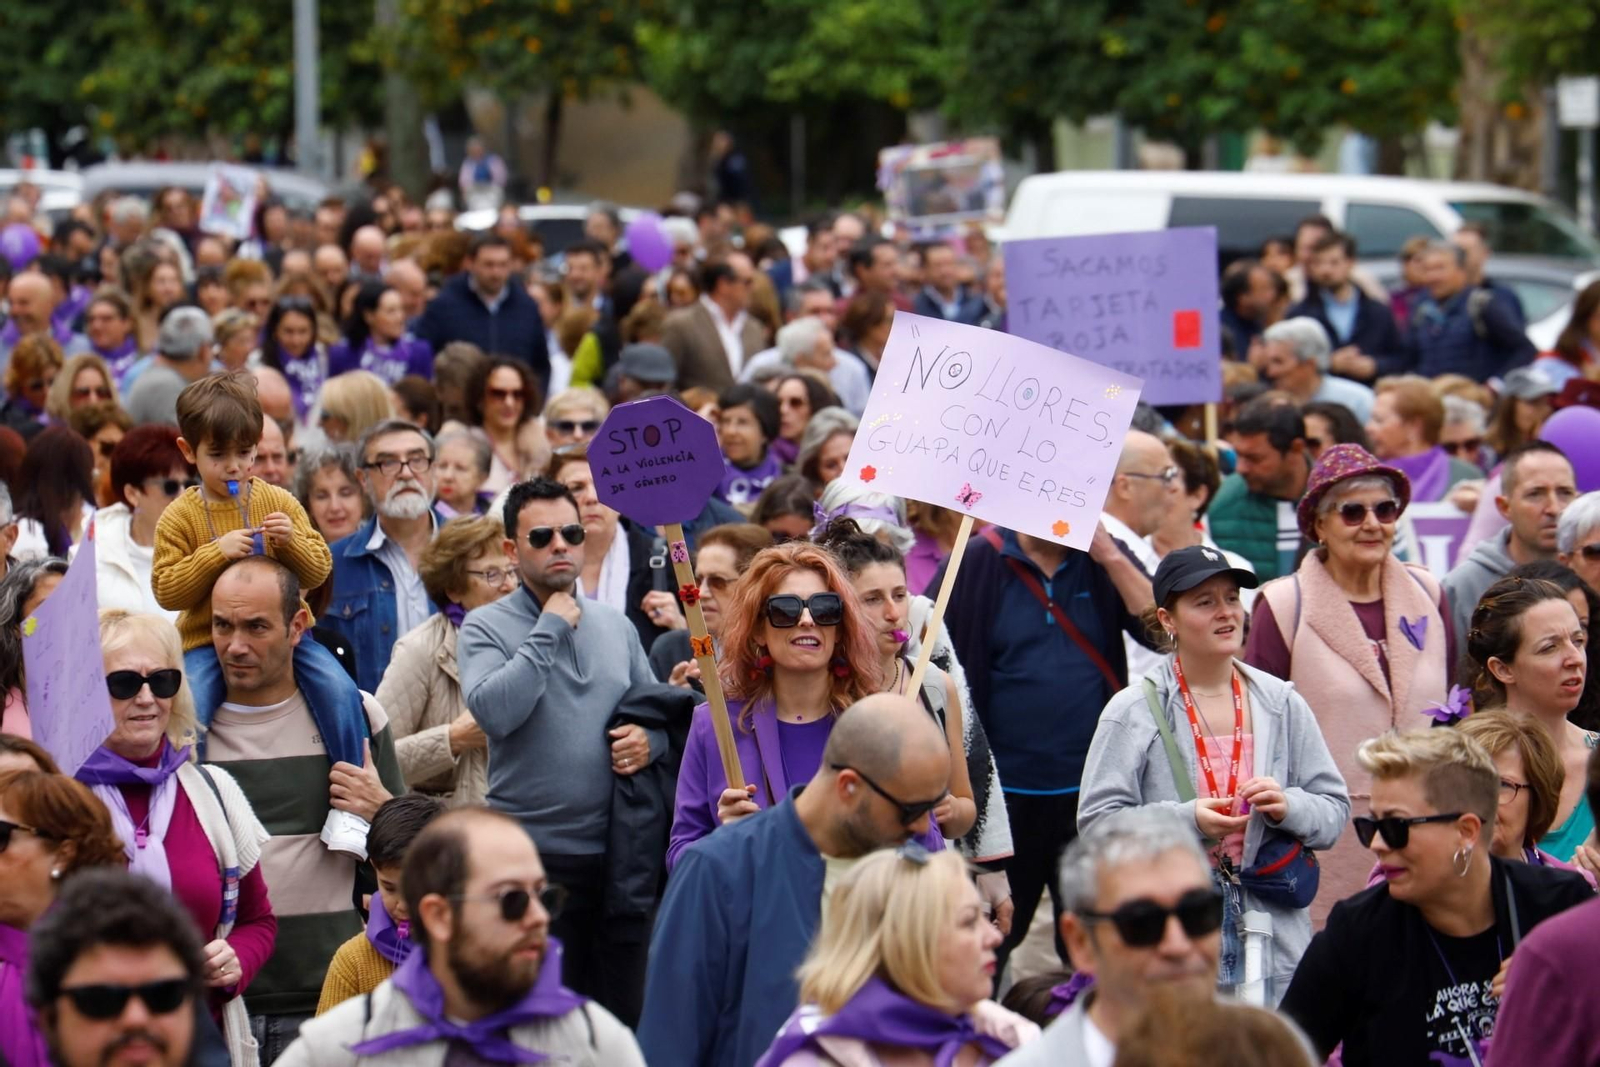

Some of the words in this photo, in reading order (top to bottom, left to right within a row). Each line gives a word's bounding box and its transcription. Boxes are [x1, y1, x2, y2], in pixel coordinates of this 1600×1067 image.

[1037, 247, 1168, 279] SACAMOS
[1017, 288, 1160, 325] TARJETA
[608, 417, 682, 456] STOP
[940, 404, 1010, 439] CON
[1018, 426, 1057, 464] LO
[867, 424, 960, 465] GUAPA
[968, 447, 1010, 482] QUE
[601, 466, 612, 478] A
[617, 464, 630, 474] LA
[611, 483, 626, 495] DE
[1436, 981, 1480, 1003] AHORA
[1425, 1002, 1446, 1023] LA
[1447, 994, 1479, 1013] QUE
